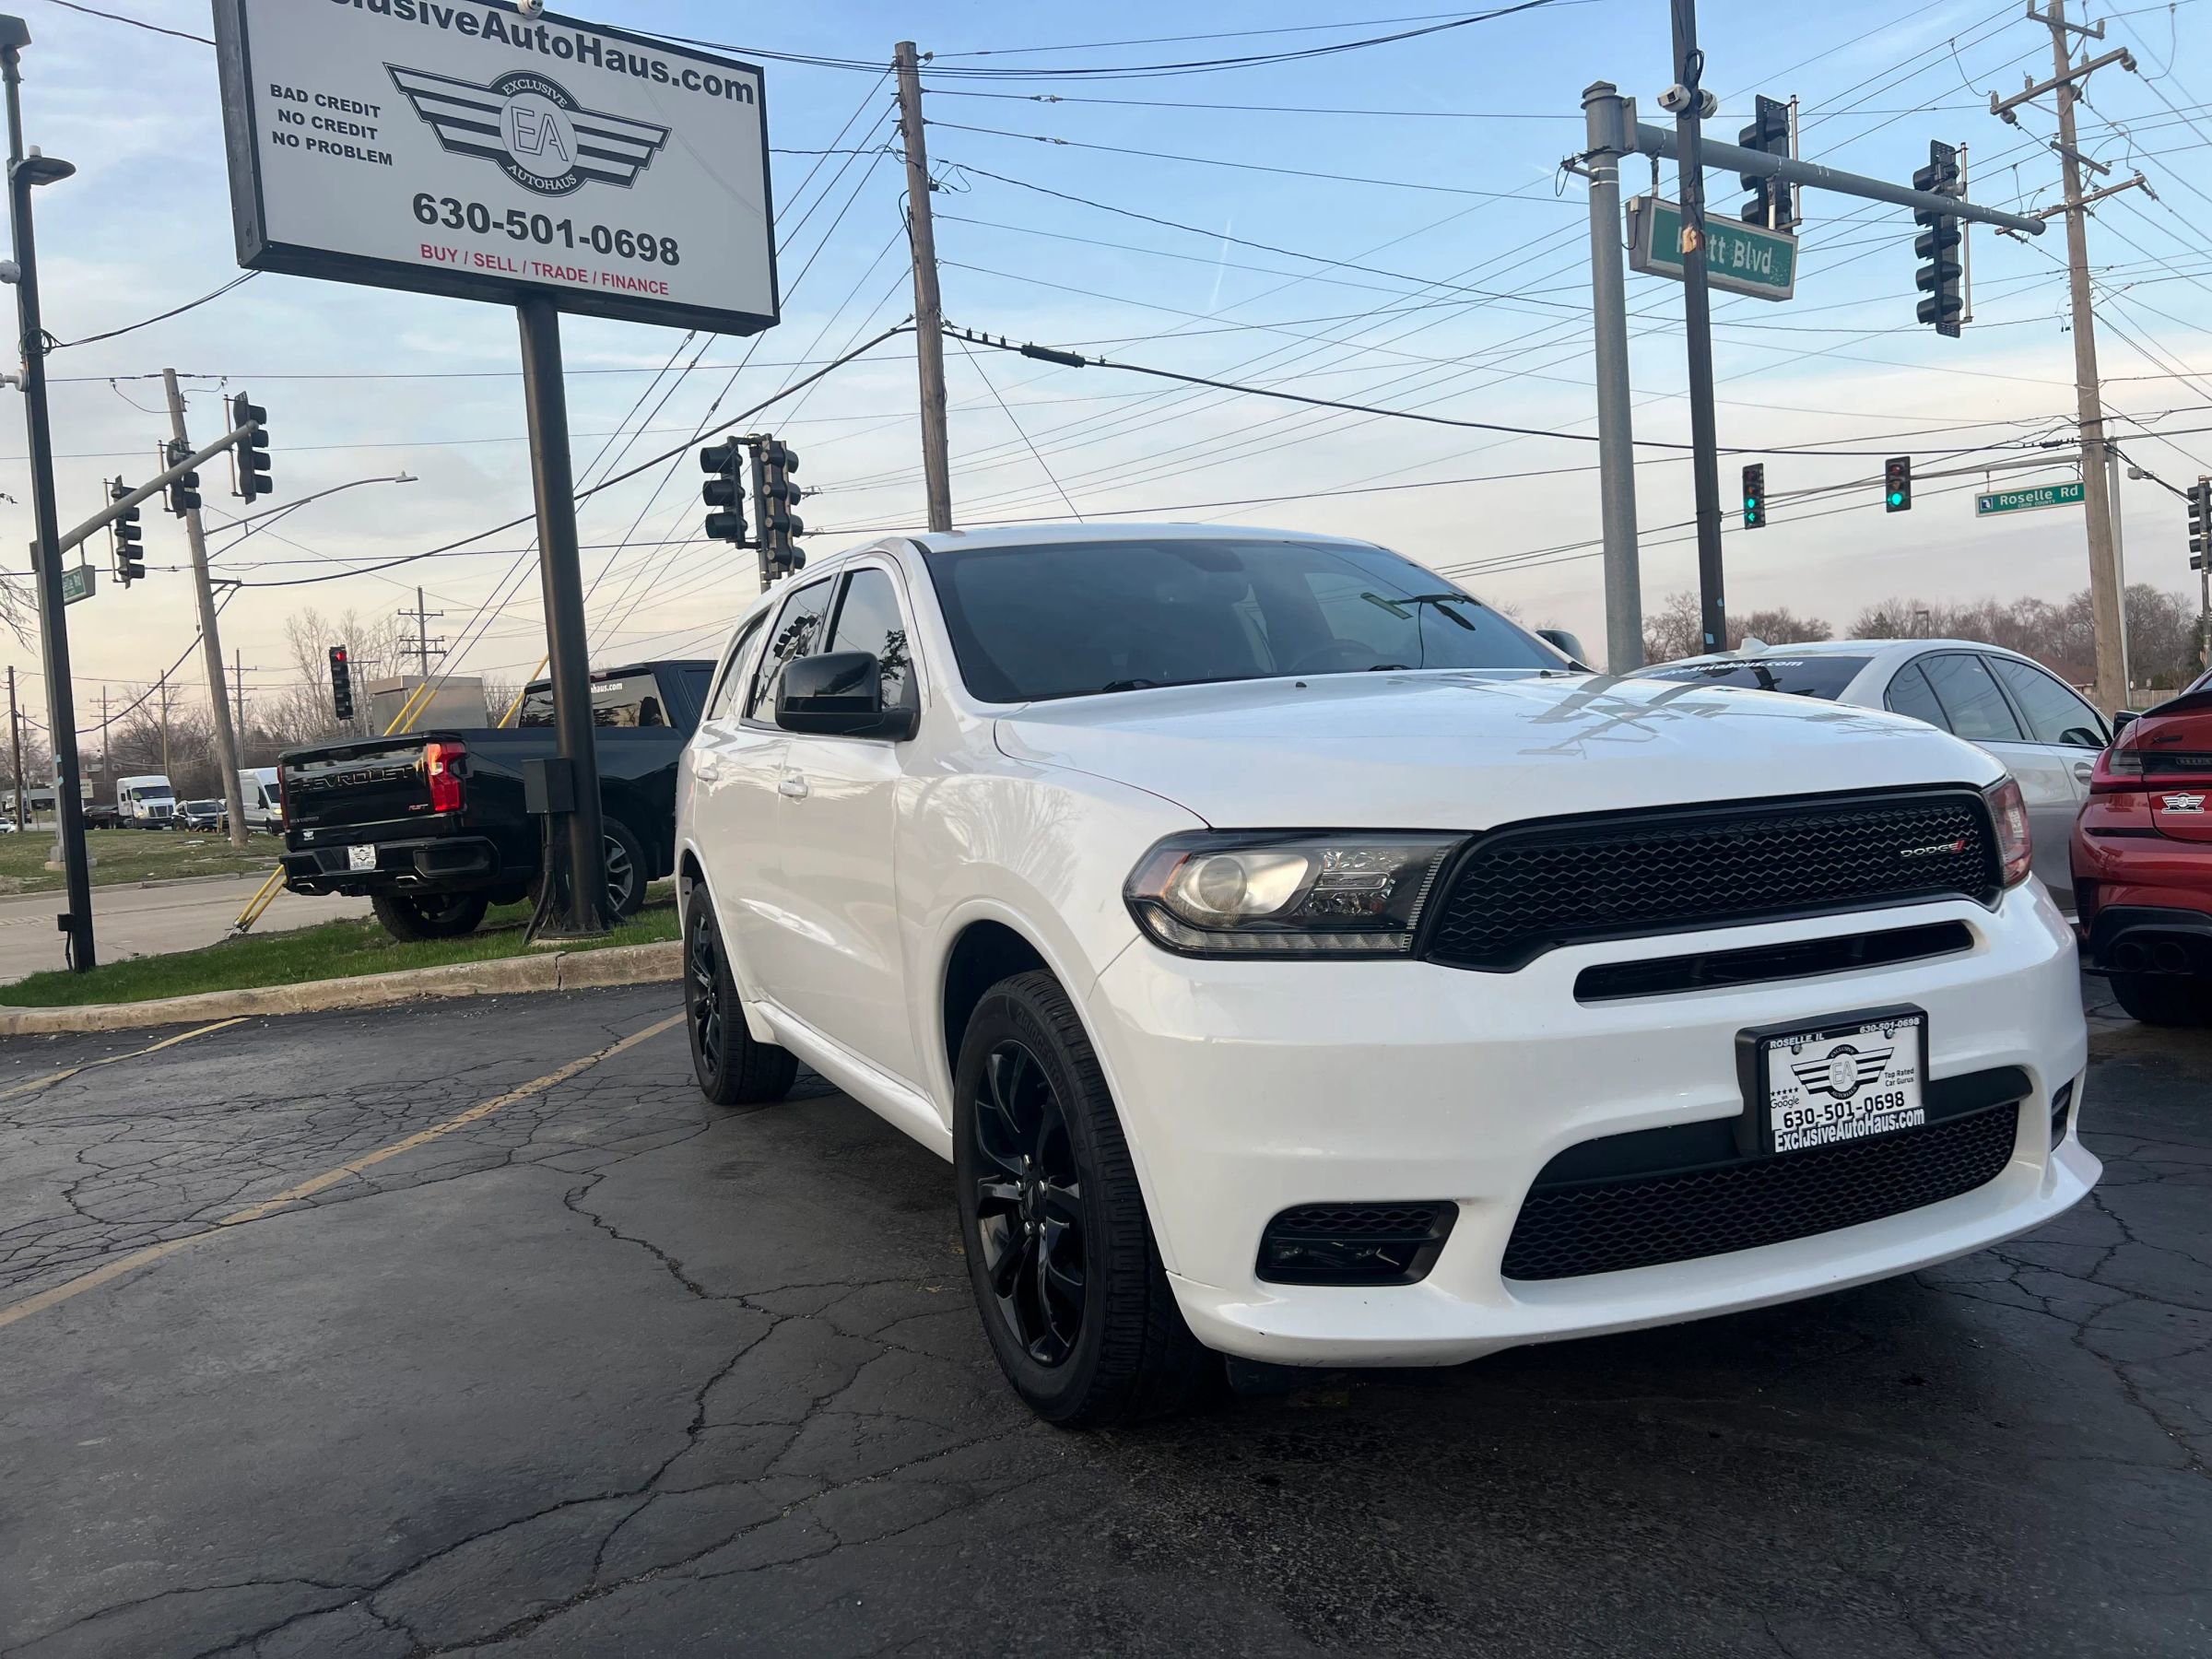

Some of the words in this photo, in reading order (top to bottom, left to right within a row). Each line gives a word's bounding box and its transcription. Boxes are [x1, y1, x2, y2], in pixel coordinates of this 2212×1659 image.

[329, 0, 755, 105] usiveAutoHaus.com
[270, 83, 309, 103] BAD
[314, 93, 381, 119] CREDIT
[501, 78, 568, 108] EXCLUSIVE
[277, 109, 305, 125] NO
[311, 115, 378, 140] CREDIT
[512, 106, 569, 162] EA
[272, 131, 300, 147] NO
[305, 137, 393, 166] PROBLEM
[507, 165, 577, 191] AUTOHAUS
[413, 193, 680, 266] 630-501-0698
[420, 243, 458, 263] BUY
[474, 253, 518, 273] SELL
[531, 262, 588, 283] TRADE
[601, 272, 670, 296] FINANCE
[1733, 239, 1772, 275] Blvd
[2000, 489, 2053, 506] Roselle
[2060, 485, 2078, 498] Rd
[289, 766, 413, 794] CHEVROLET
[1900, 842, 1959, 857] DODGE
[1771, 1034, 1814, 1049] ROSELLE
[1816, 1032, 1825, 1041] IL
[1859, 1017, 1920, 1034] 630-501-0698
[1833, 1060, 1854, 1086] EA
[1885, 1079, 1896, 1088] Car
[1897, 1077, 1914, 1085] Gurus
[1897, 1067, 1914, 1077] Rated
[1771, 1095, 1800, 1110] Google
[1783, 1091, 1905, 1129] 630-501-0698
[1774, 1108, 1925, 1153] ExclusiveAutoHaus.com
